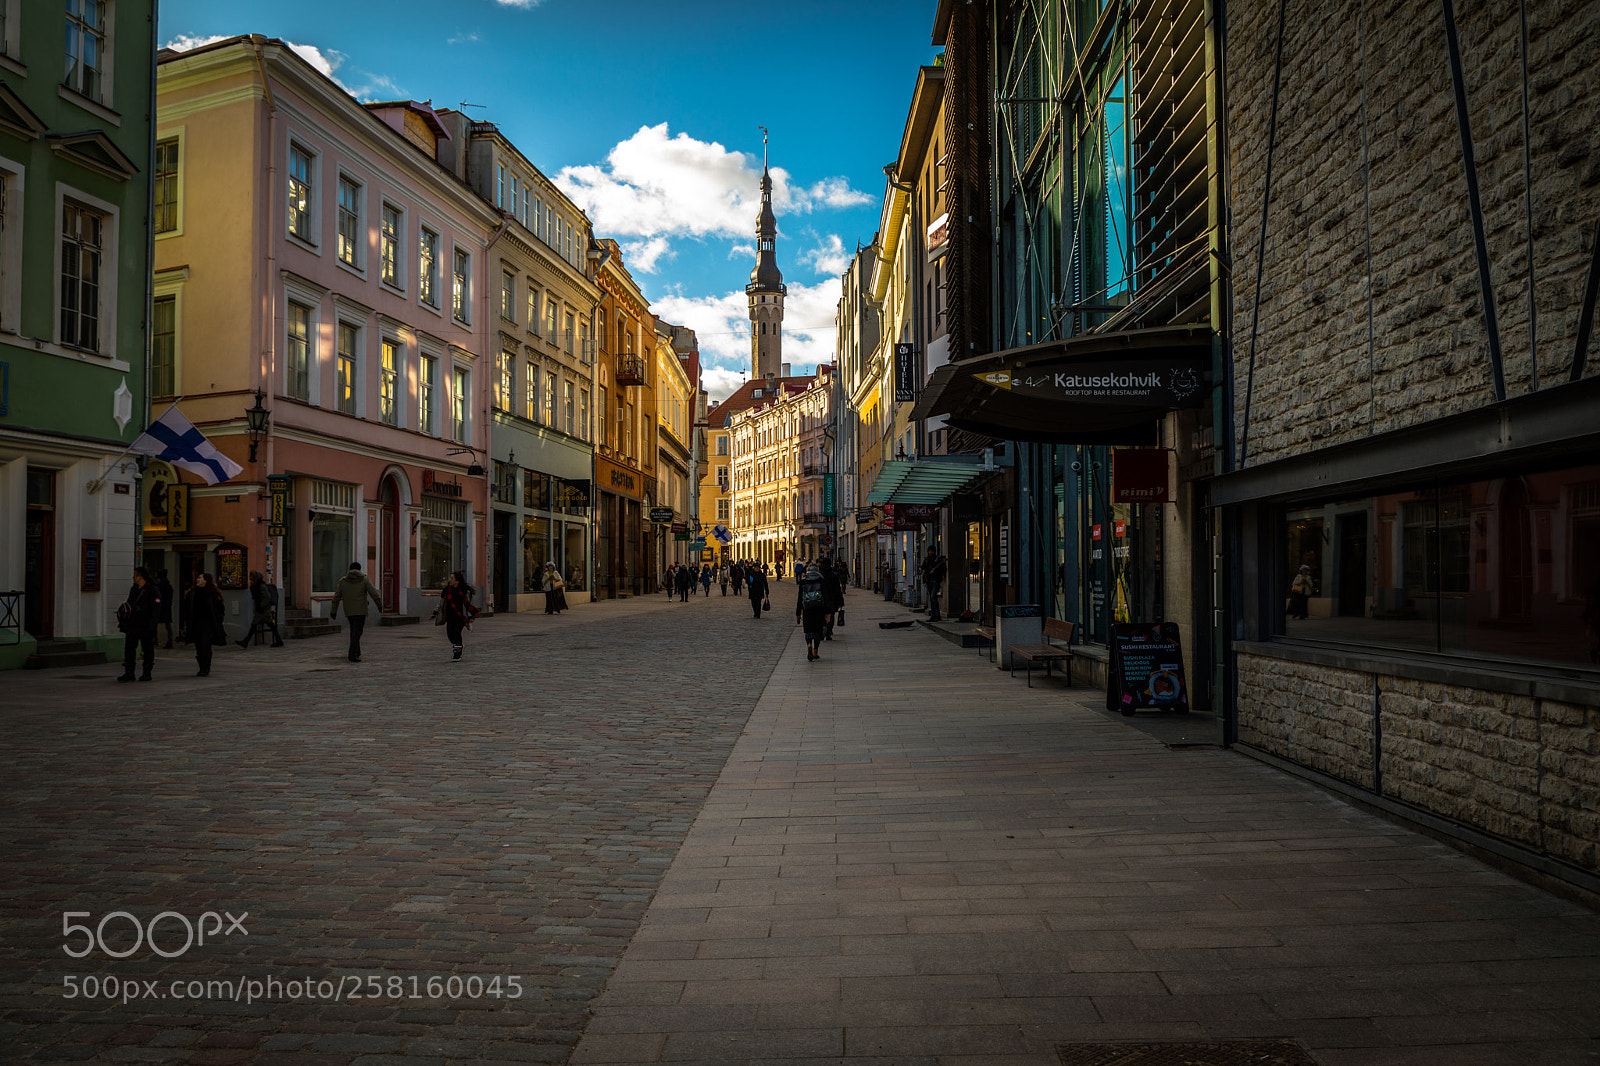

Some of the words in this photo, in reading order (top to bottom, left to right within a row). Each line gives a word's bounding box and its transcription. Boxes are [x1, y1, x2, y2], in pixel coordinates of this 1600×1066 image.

[1054, 372, 1162, 388] Katusekohvik
[1120, 488, 1154, 497] Rimi
[173, 490, 182, 527] BAAR
